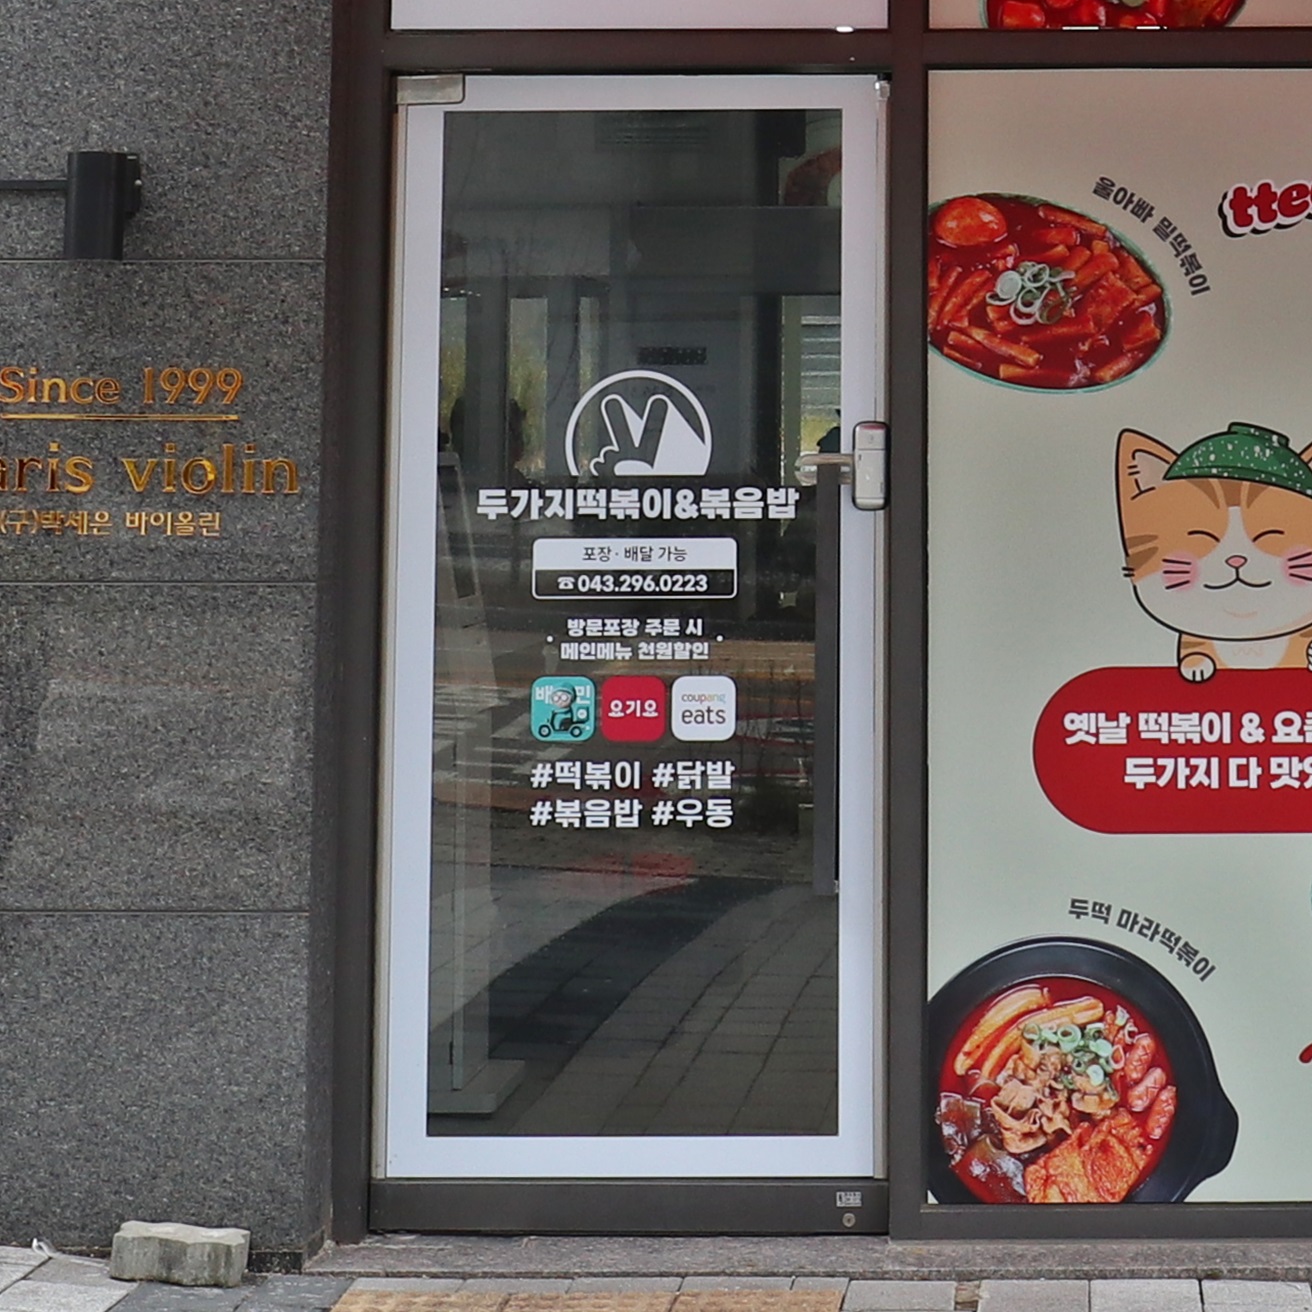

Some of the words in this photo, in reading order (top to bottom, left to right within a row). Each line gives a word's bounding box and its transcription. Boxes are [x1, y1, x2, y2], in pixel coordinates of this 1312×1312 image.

[1152, 216, 1211, 296] 밀떡볶이
[0, 367, 120, 404] Since
[143, 367, 243, 404] 1999
[122, 442, 299, 494] violin
[476, 488, 800, 520] 두가지떡볶이&볶음밥
[125, 511, 222, 537] 바이올린
[583, 546, 613, 562] 포장
[624, 546, 654, 562] 배달
[658, 546, 688, 562] 가능
[578, 575, 708, 592] 043.296.0223
[567, 619, 639, 637] 방문포장
[645, 619, 680, 637] 주문
[686, 619, 703, 636] 시
[561, 643, 632, 660] 메인메뉴
[638, 643, 709, 660] 천원할인
[608, 700, 659, 717] 요기요
[681, 692, 726, 705] coupang
[681, 705, 726, 724] eats
[1063, 713, 1130, 745] 옛날
[1138, 712, 1232, 744] 떡볶이
[1239, 713, 1265, 743] &
[530, 761, 640, 790] #떡볶이
[652, 761, 735, 790] #닭발
[1123, 757, 1220, 789] 두가지
[1227, 757, 1262, 789] 다
[530, 799, 643, 828] #볶음밥
[651, 799, 734, 828] #우동
[1068, 898, 1113, 925] 두떡
[1115, 907, 1218, 984] 마라떡볶이
